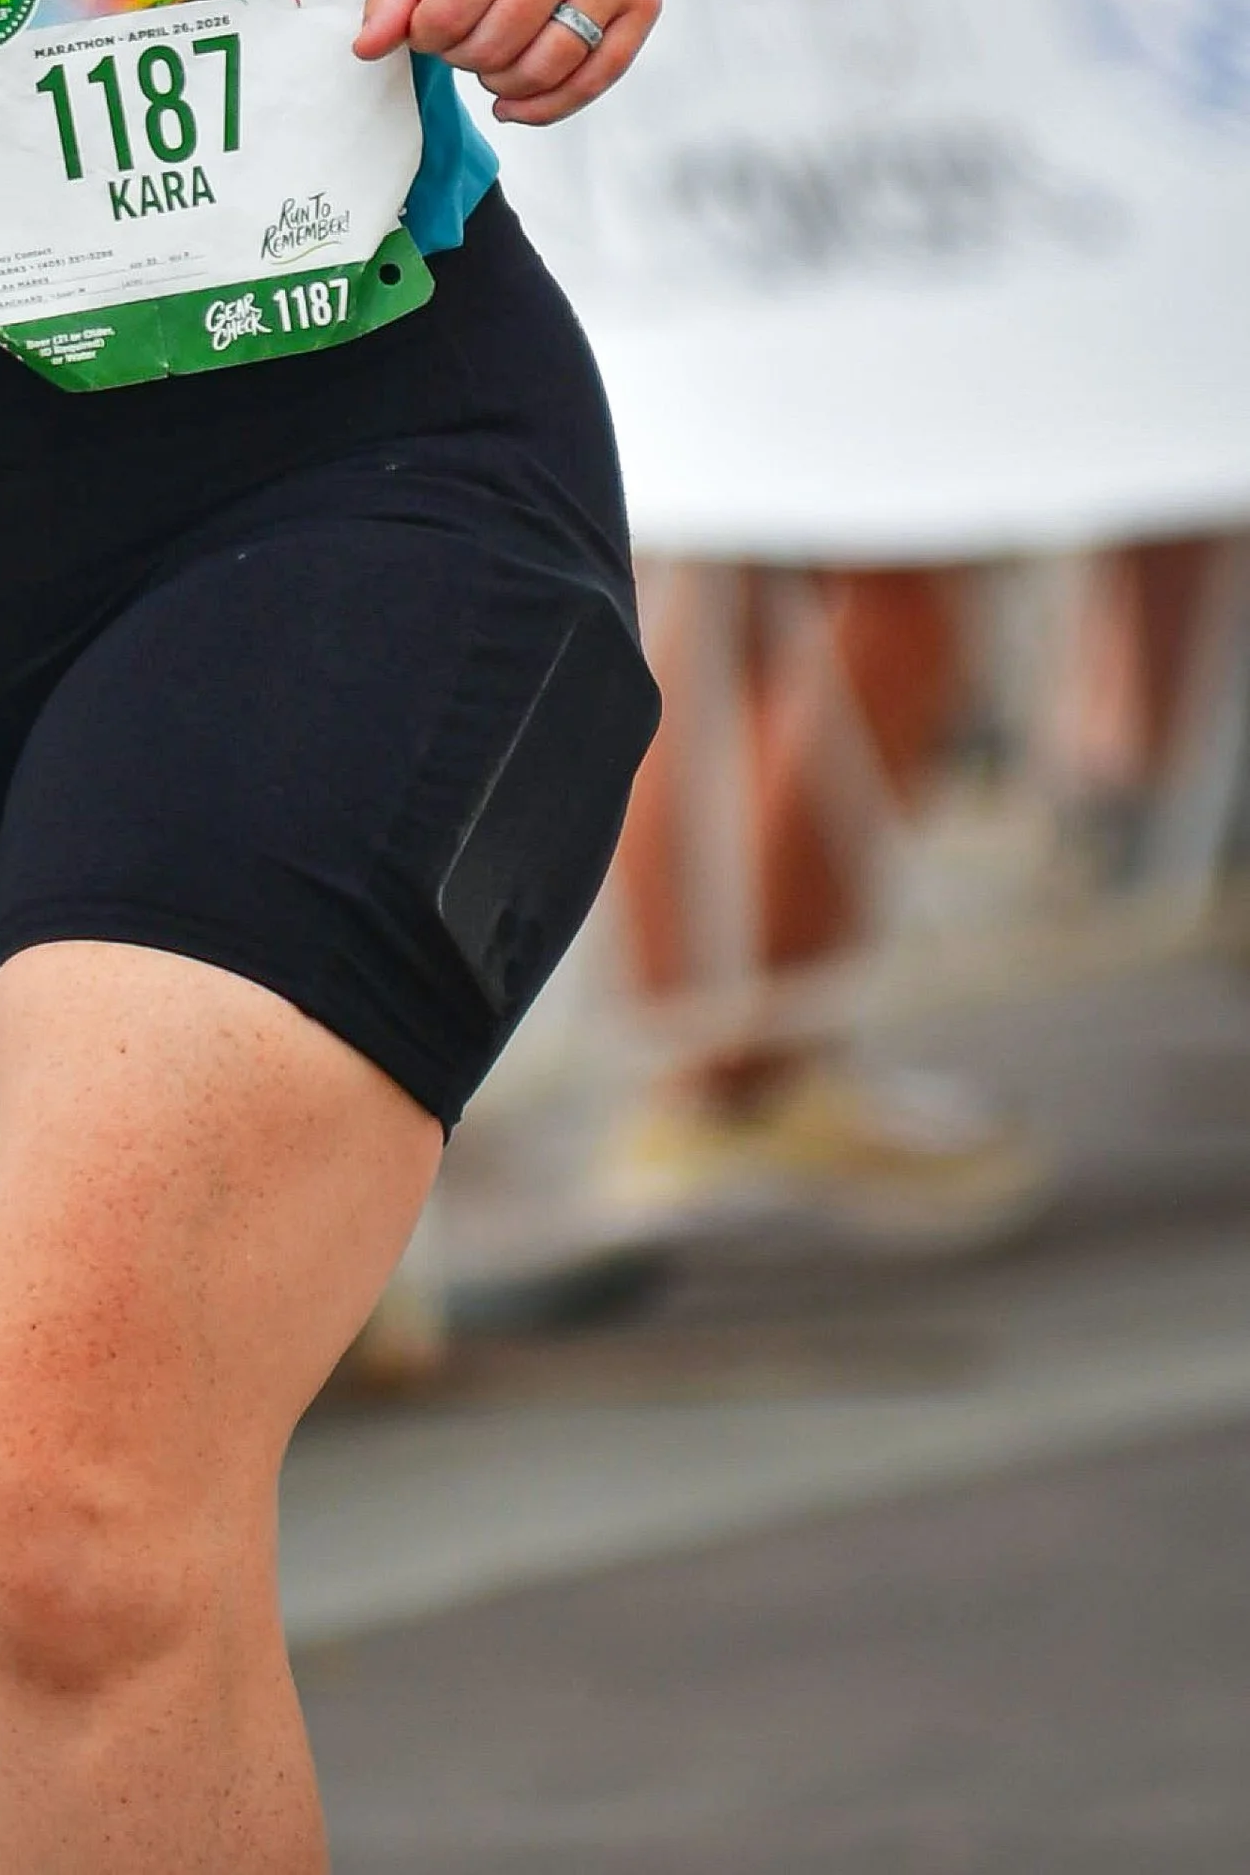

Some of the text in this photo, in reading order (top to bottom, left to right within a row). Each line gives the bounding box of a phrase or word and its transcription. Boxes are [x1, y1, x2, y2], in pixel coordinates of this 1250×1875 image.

[34, 36, 115, 59] MARATHON
[128, 27, 169, 42] APRIL
[197, 15, 231, 30] 2026
[36, 32, 241, 181] 1187
[108, 165, 217, 221] KARA
[14, 247, 52, 261] Contact
[273, 277, 349, 332] 1187
